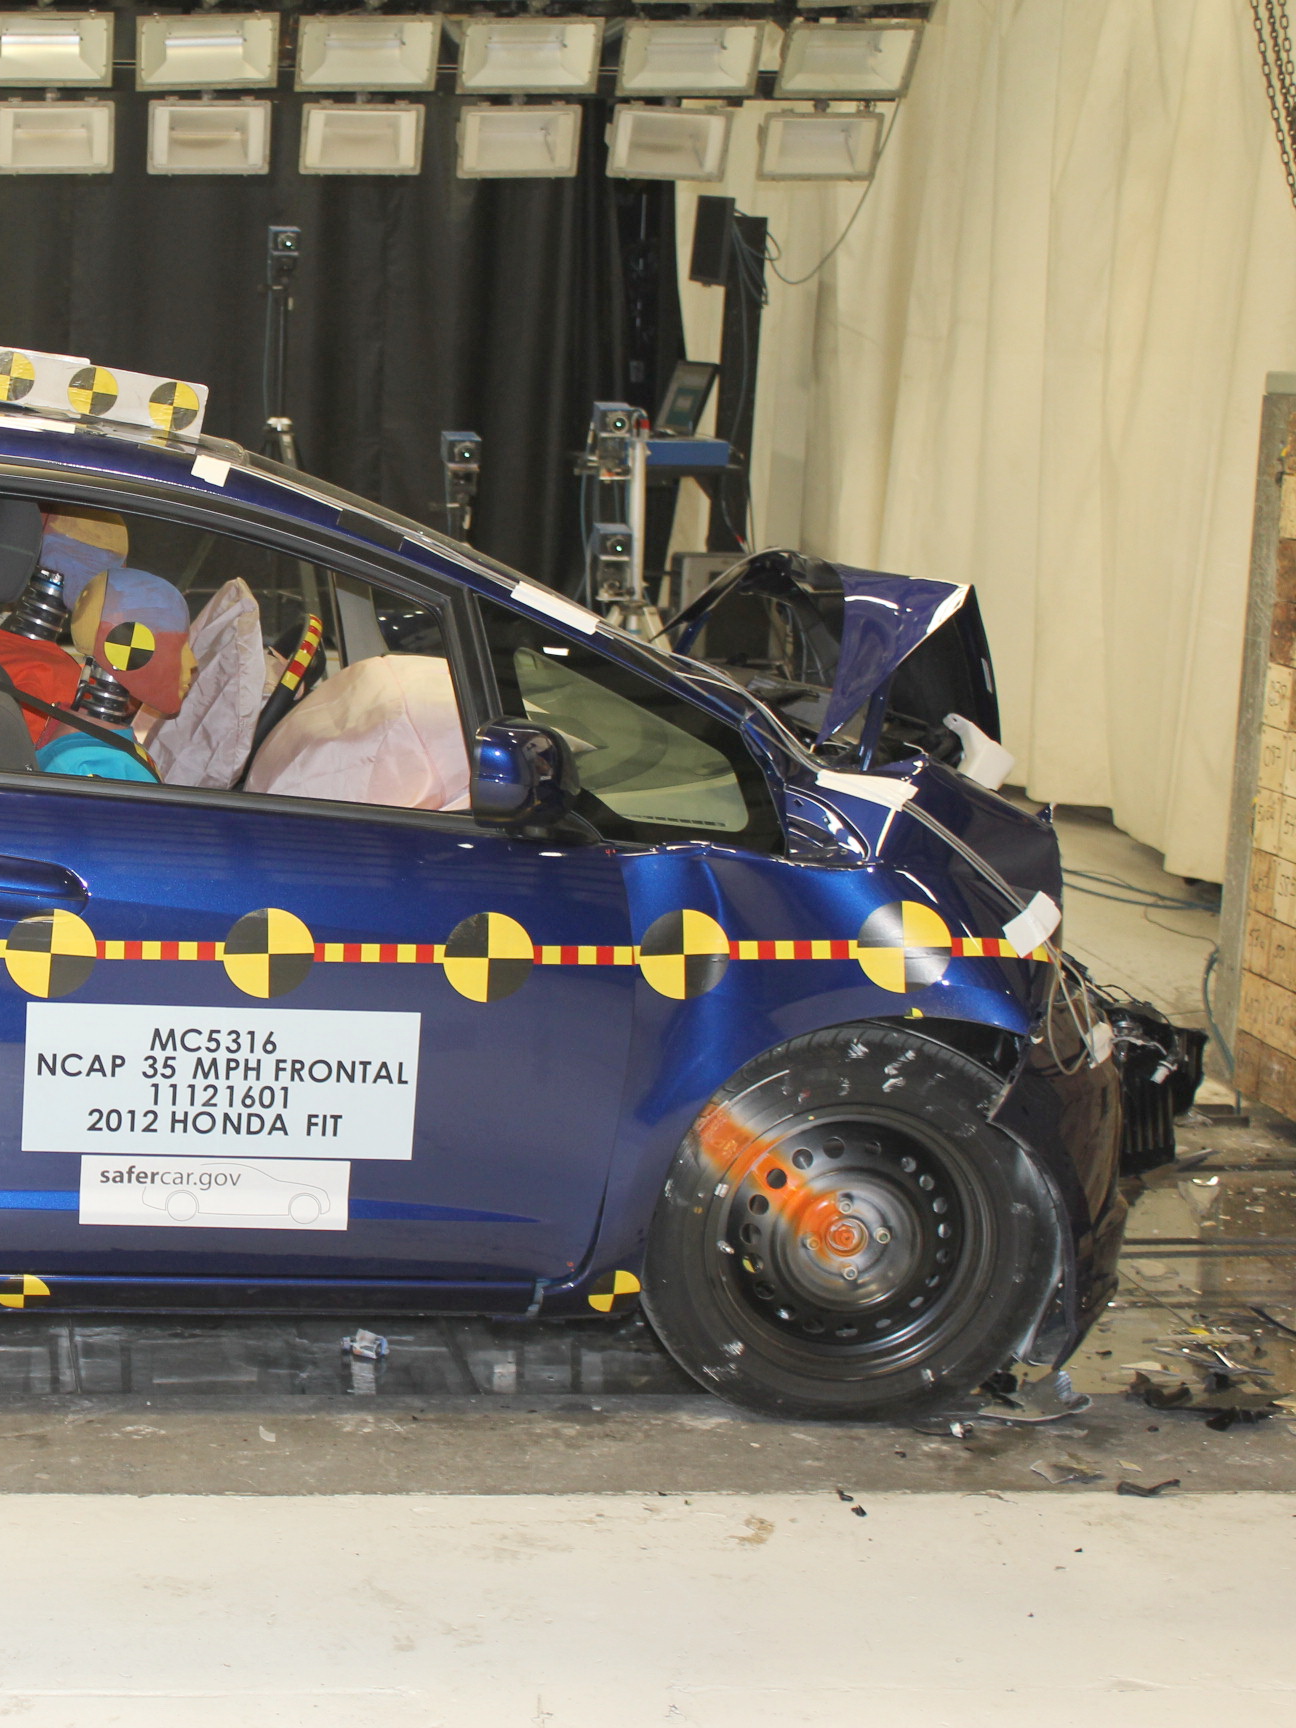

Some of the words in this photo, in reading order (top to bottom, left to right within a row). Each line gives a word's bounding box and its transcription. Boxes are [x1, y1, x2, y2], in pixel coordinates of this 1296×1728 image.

[150, 1028, 278, 1055] MC5316
[37, 1053, 126, 1078] NCAP
[141, 1056, 177, 1080] 35
[192, 1057, 262, 1082] MPH
[274, 1059, 409, 1085] FRONTAL
[150, 1083, 290, 1110] 11121601
[86, 1108, 159, 1133] 2012
[169, 1112, 290, 1136] HONDA
[305, 1114, 343, 1138] FIT
[99, 1165, 242, 1191] safercar.gov
